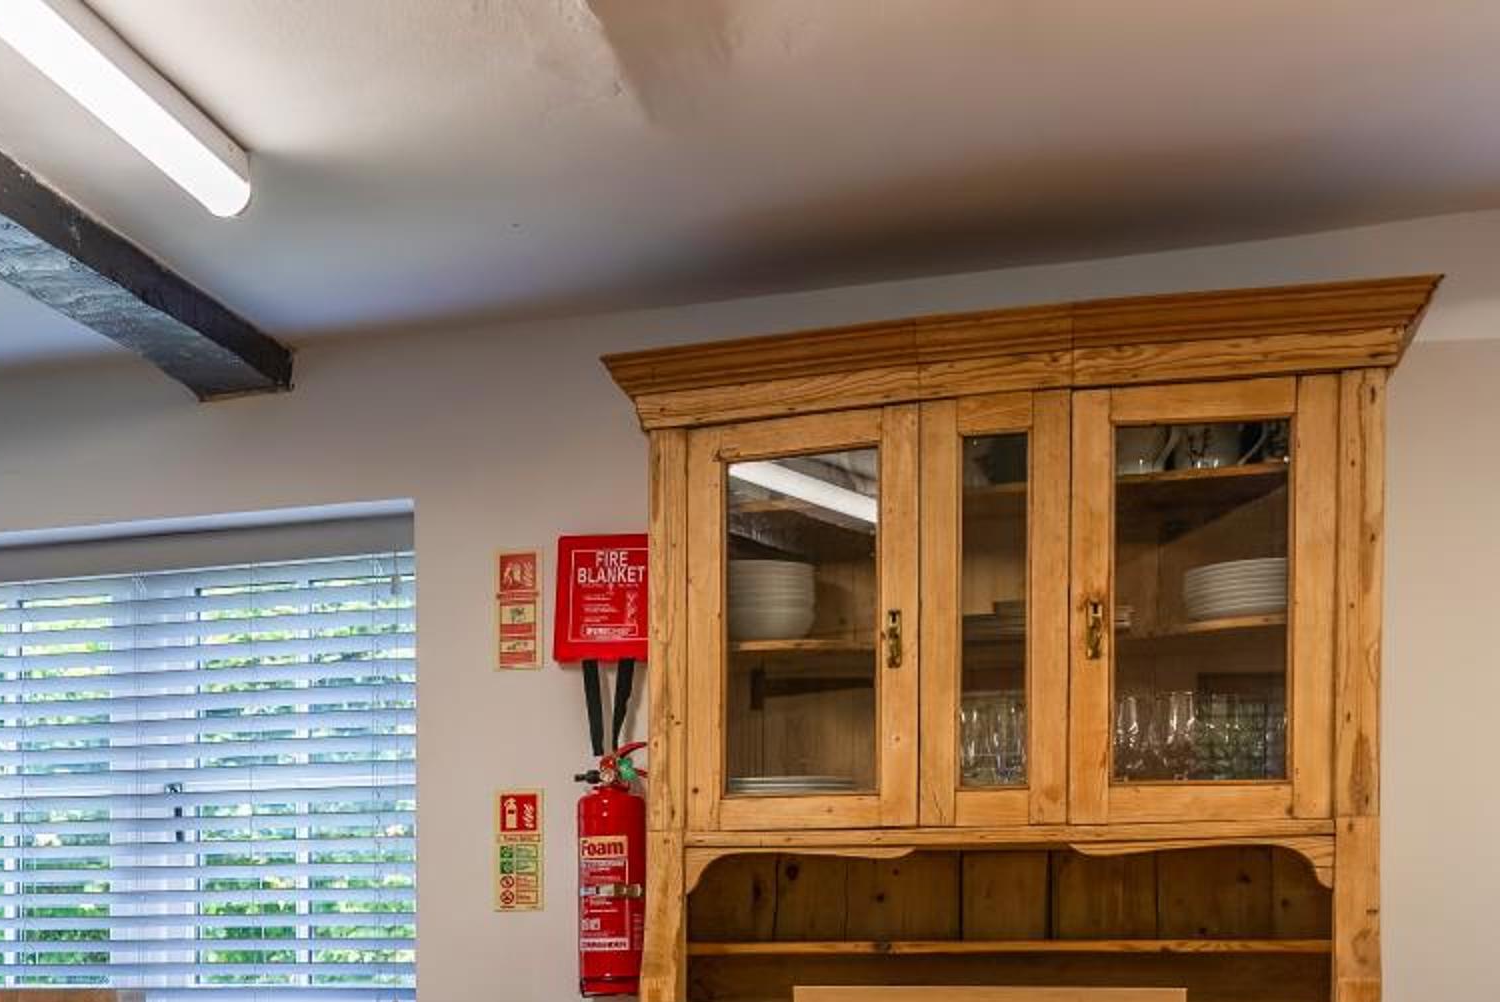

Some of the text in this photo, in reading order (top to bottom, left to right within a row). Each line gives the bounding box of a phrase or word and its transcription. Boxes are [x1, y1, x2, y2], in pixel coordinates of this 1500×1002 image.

[595, 551, 628, 568] FIRE
[577, 566, 645, 584] BLANKET
[581, 839, 624, 856] Foam
